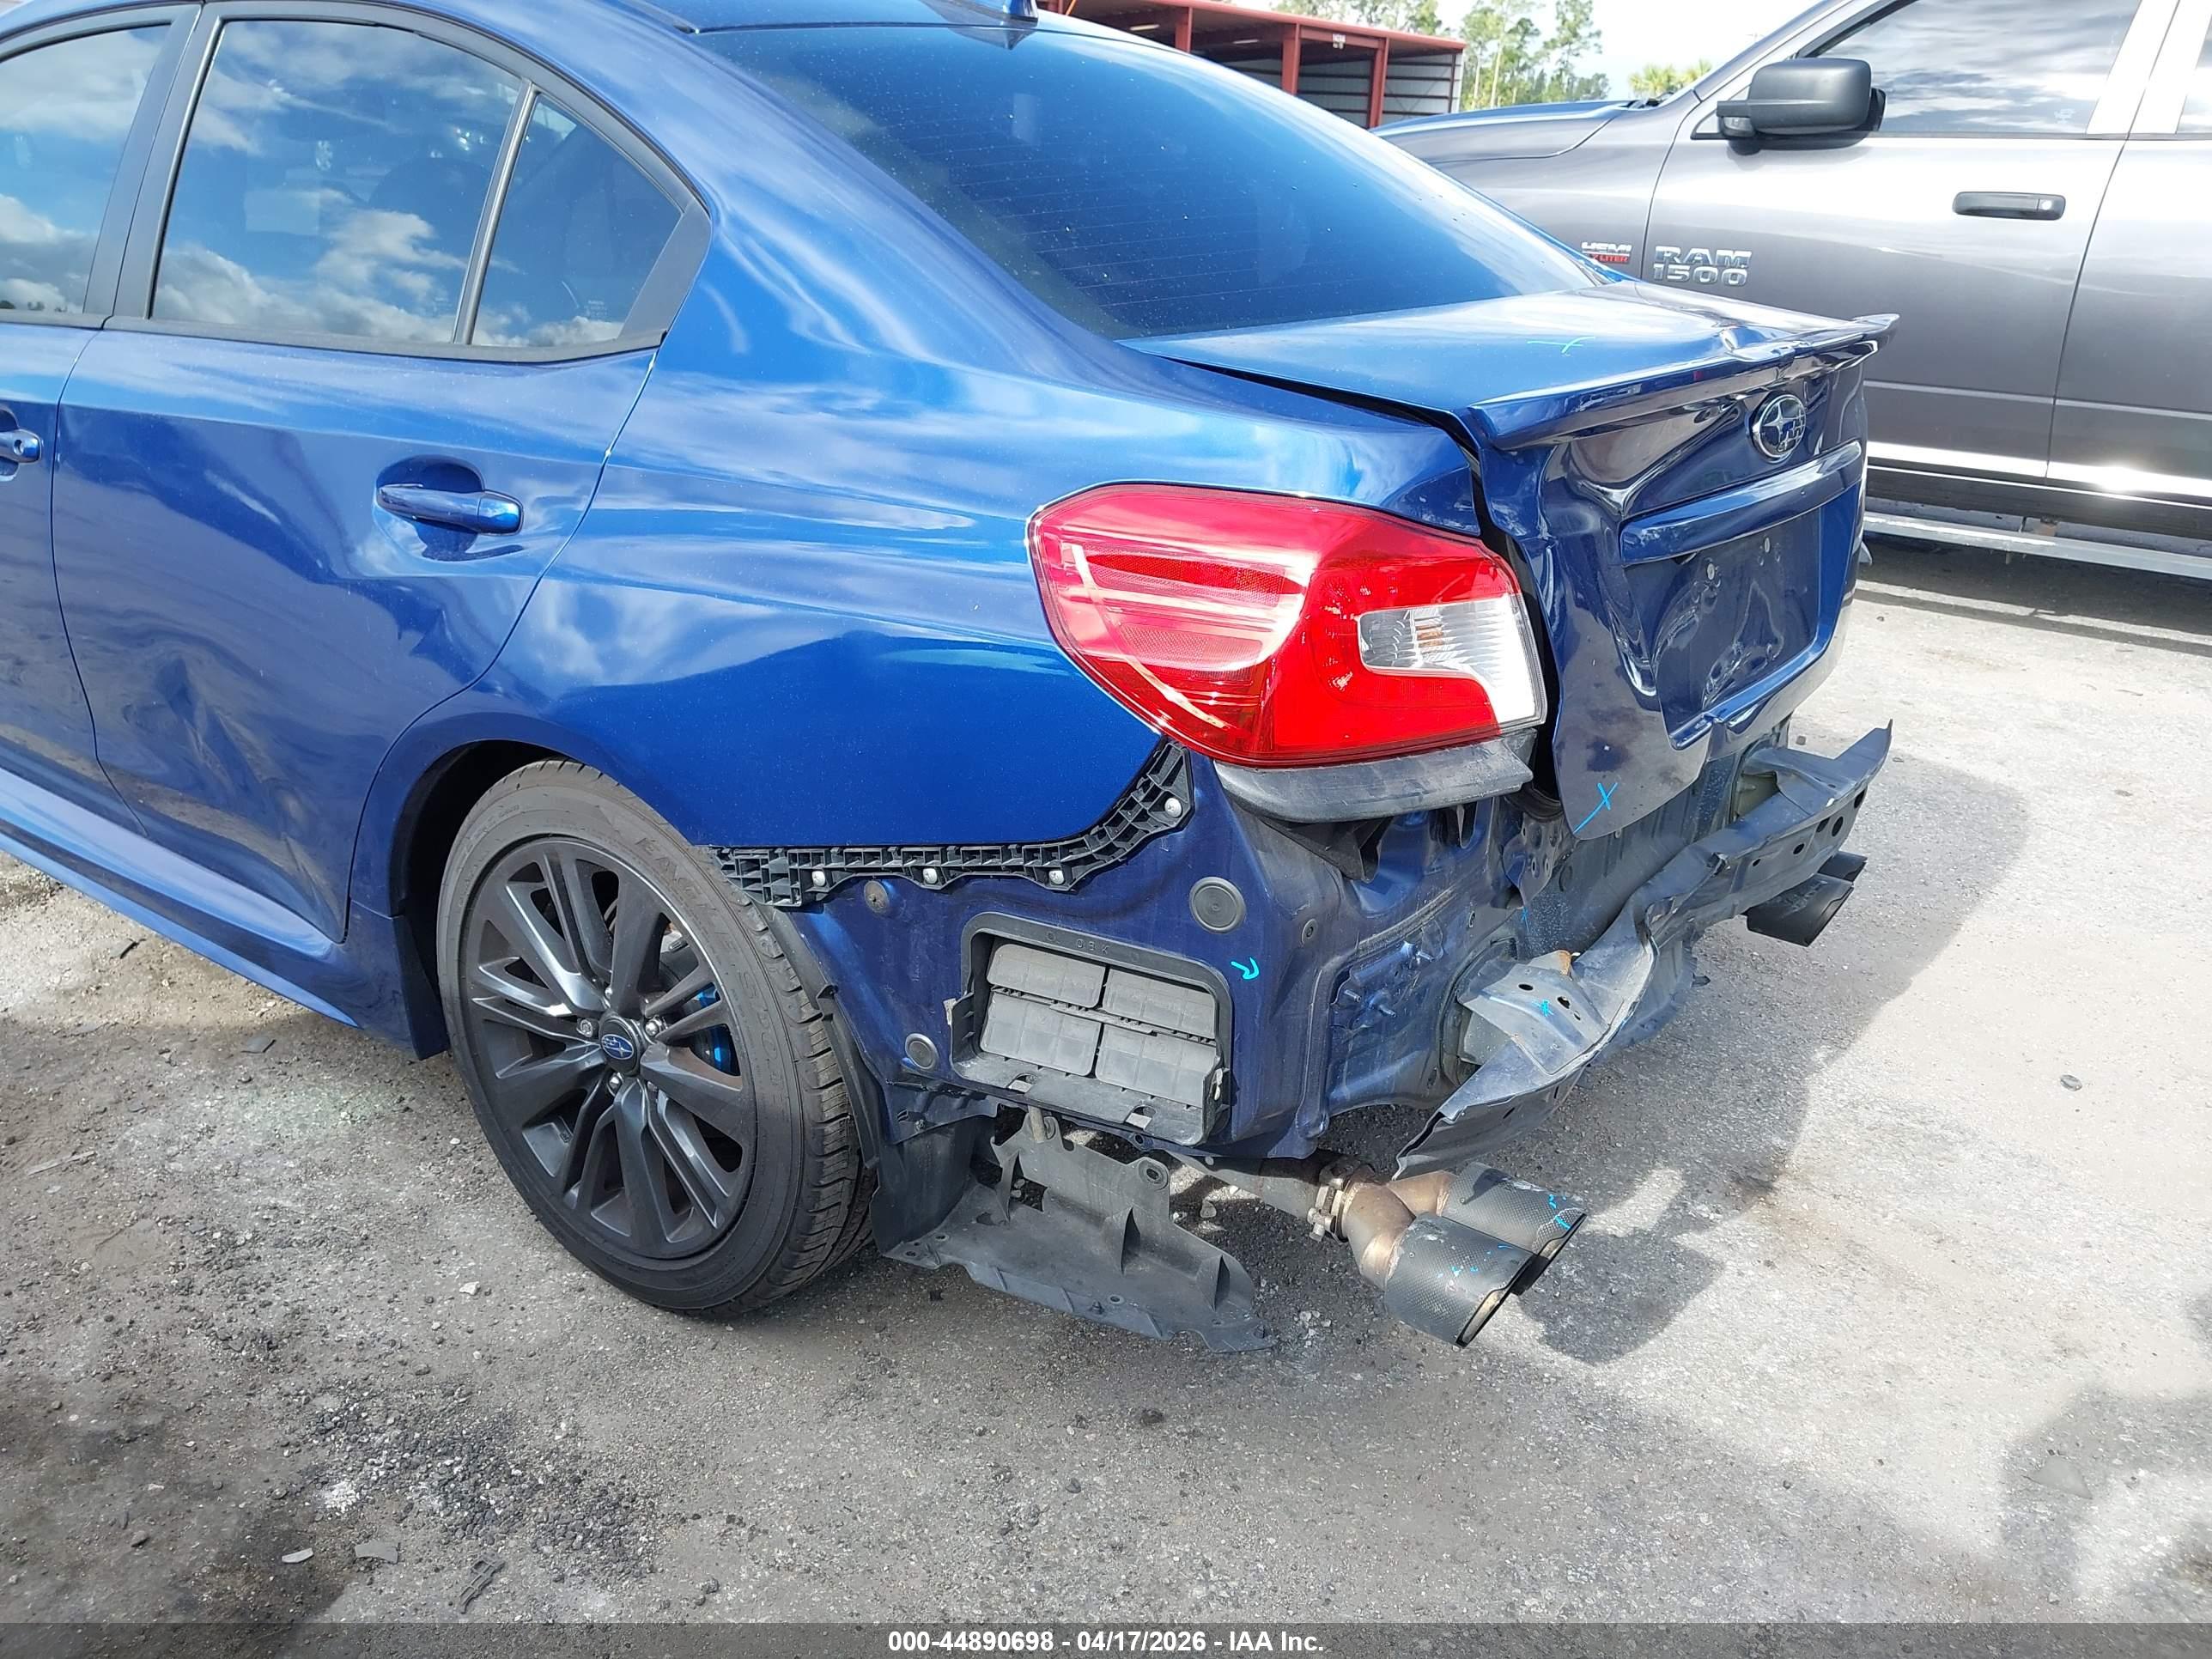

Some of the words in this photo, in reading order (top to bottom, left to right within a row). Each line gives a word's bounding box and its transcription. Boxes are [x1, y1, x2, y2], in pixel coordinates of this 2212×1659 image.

[1581, 241, 1632, 252] HEMI
[1600, 254, 1629, 263] LITER
[1654, 246, 1752, 268] RAM
[1653, 263, 1748, 286] 1500
